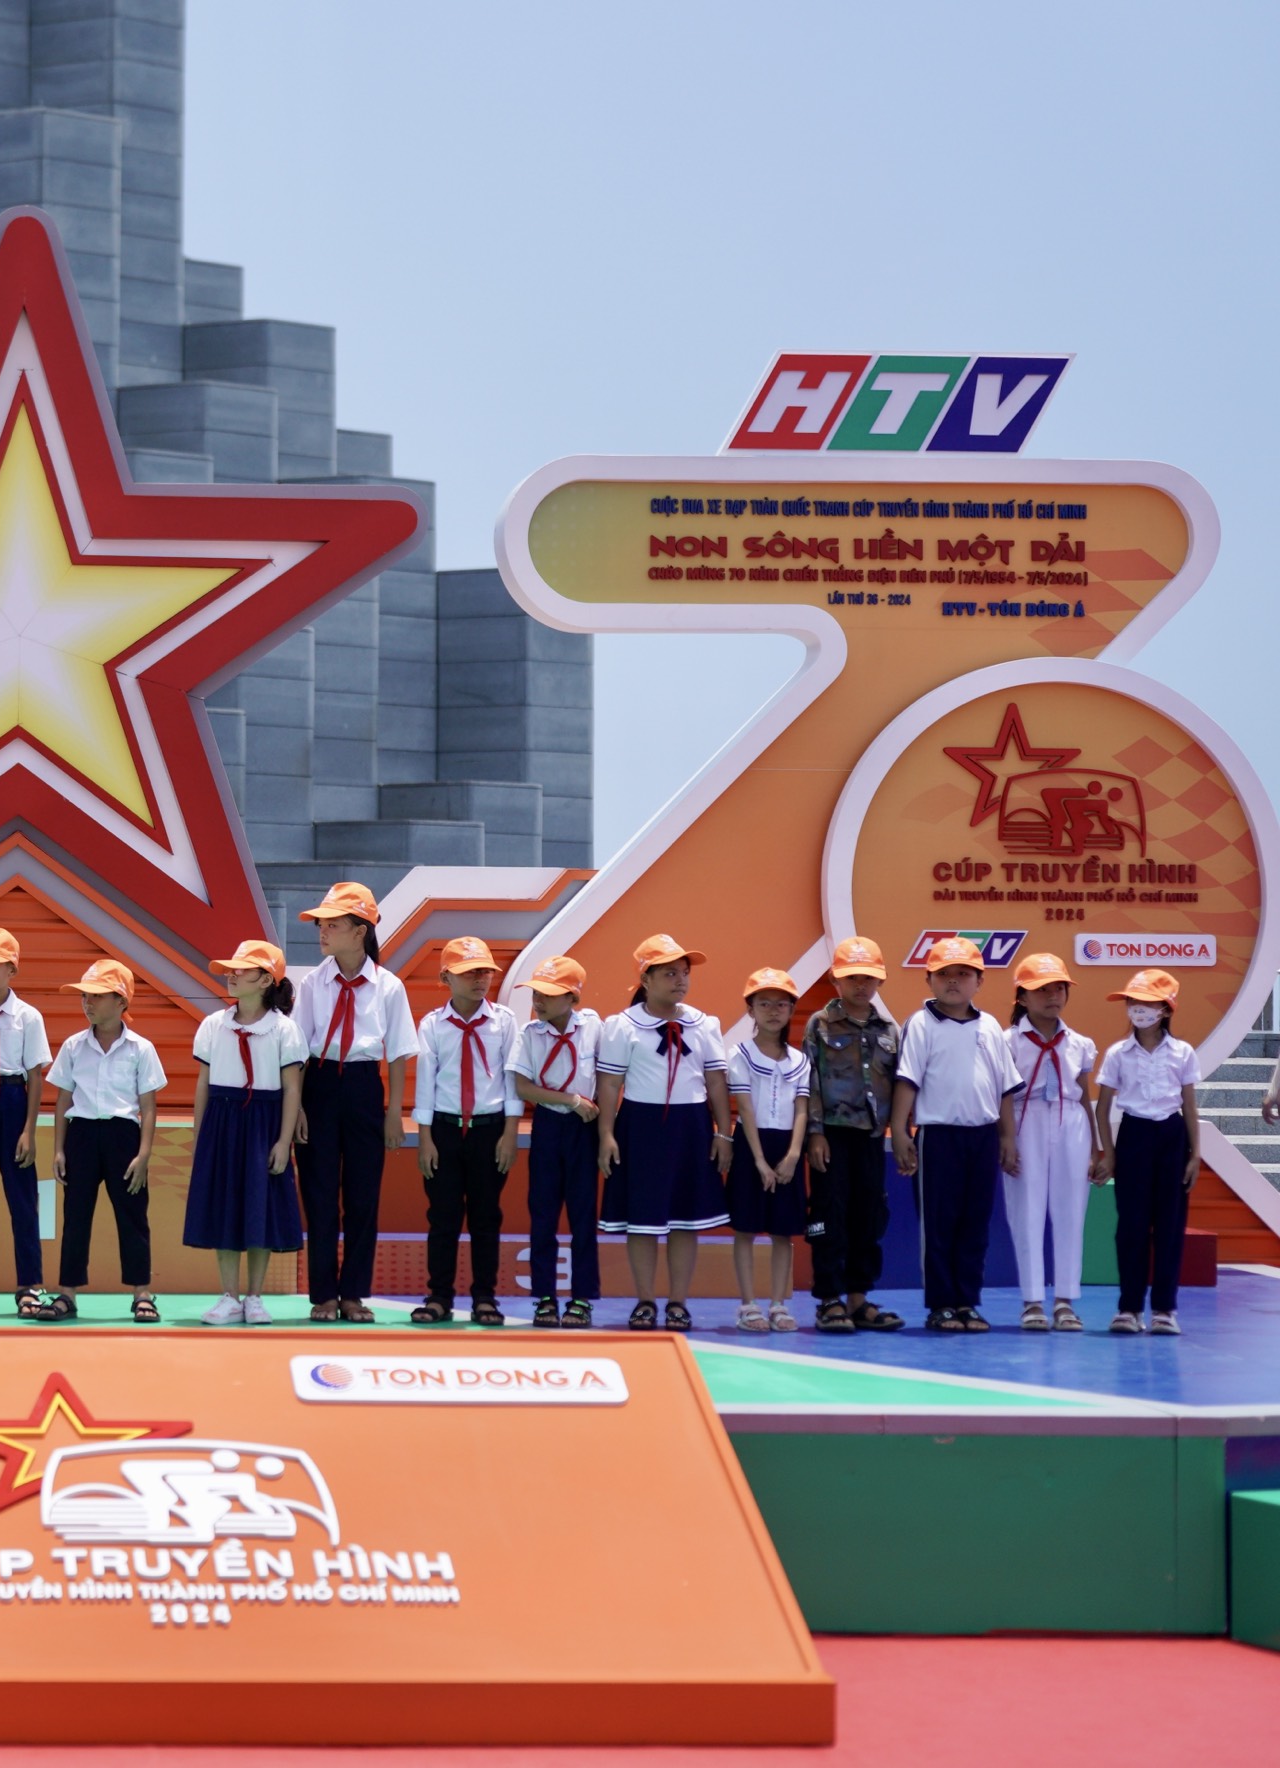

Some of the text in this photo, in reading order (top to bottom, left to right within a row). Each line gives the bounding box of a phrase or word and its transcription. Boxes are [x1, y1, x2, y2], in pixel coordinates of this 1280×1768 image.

[745, 367, 1053, 439] HTV
[650, 496, 1087, 519] CUỘC ĐUA XE ĐẠP TOÀN QUỐC TRANH CÚP TRUYỀN HÌNH THÀNH PHỐ HỒ CHÍ MINH
[650, 528, 1085, 566] NON SÔNG LIỀN MỘT DẢI
[648, 565, 683, 580] CHÀO
[686, 565, 726, 581] MỪNG
[729, 567, 746, 581] 70
[749, 566, 780, 582] NĂM
[783, 565, 818, 582] CHIẾN
[822, 564, 864, 582] THẮNG
[867, 567, 897, 585] ĐIỆN
[899, 567, 927, 583] BIÊN
[930, 567, 955, 583] PHỦ
[827, 590, 845, 605] LẦN
[847, 591, 864, 605] THỨ
[867, 593, 878, 605] 36
[887, 594, 911, 606] 2024
[942, 602, 977, 616] HTV
[987, 599, 1021, 616] TÔN
[1074, 600, 1085, 617] Á
[933, 855, 1197, 884] CÚP TRUYỀN HÌNH
[933, 886, 1198, 903] ĐÀI TRUYỀN HÌNH THÀNH PHỐ HỒ CHÍ MINH
[1045, 908, 1085, 921] 2024
[1106, 943, 1210, 957] TON DONG A
[363, 1368, 607, 1388] TON DONG A
[51, 1538, 295, 1580] TRUYỀN
[312, 1543, 456, 1582] HÌNH
[68, 1577, 133, 1601] HÌNH
[138, 1579, 226, 1602] THÀNH
[230, 1577, 288, 1602] PHỐ
[292, 1577, 333, 1602] HỒ
[338, 1579, 387, 1603] CHÍ
[391, 1585, 460, 1604] MINH
[150, 1602, 232, 1625] 2024
